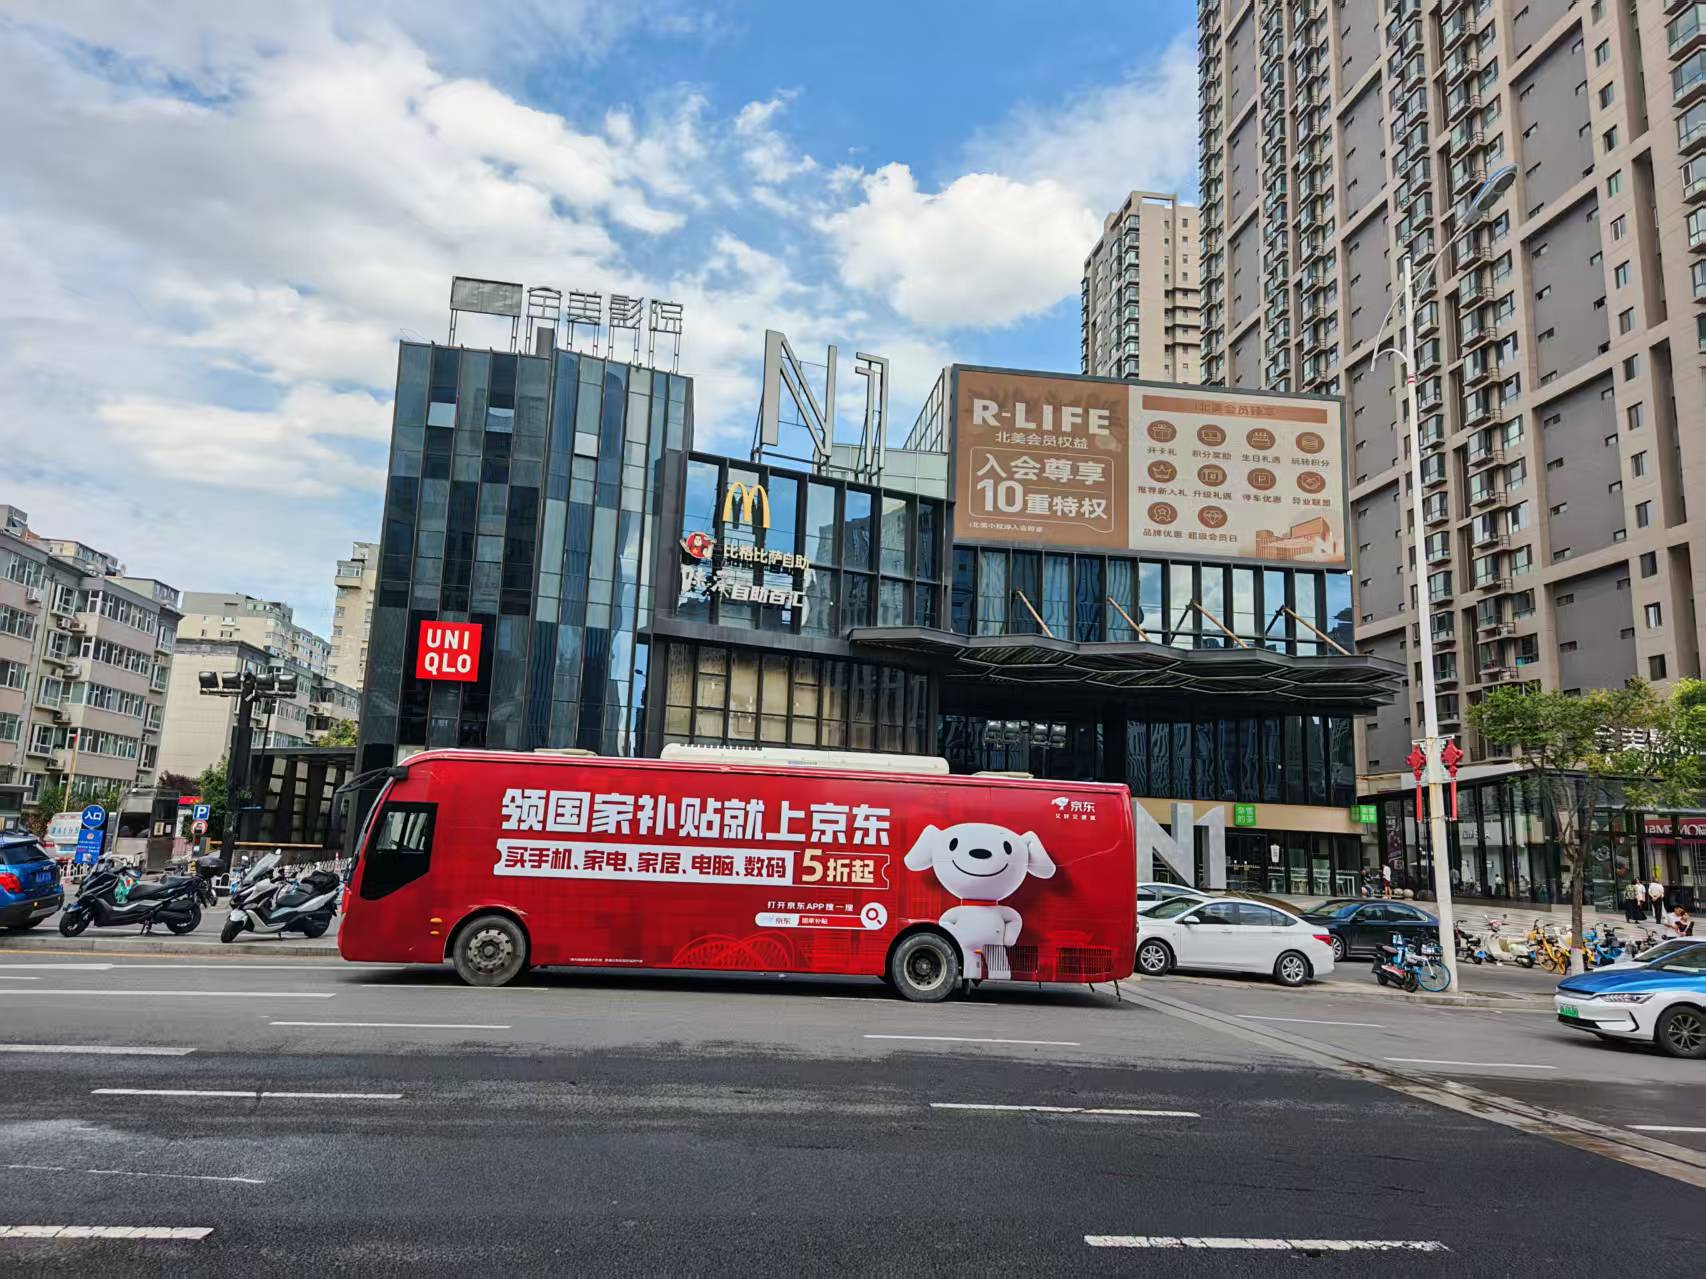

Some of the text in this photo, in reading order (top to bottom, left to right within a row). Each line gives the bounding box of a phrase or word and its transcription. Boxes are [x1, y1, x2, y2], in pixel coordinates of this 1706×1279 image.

[973, 398, 1111, 436] R-LIFE
[995, 431, 1089, 449] 北美会员权益
[976, 453, 1105, 486] 入会尊享
[976, 478, 1108, 519] 10重特权
[724, 543, 810, 570] 比格比萨自助
[426, 628, 470, 651] UNI
[424, 652, 472, 675] QLO
[84, 810, 103, 820] 入口
[197, 806, 207, 818] P
[501, 788, 891, 846] 领国家补贴就上京东
[1070, 801, 1096, 812] 京东
[504, 846, 786, 878] 买手机、家电、家居、电脑、数码
[802, 849, 874, 883] 5折起
[767, 900, 854, 912] 打开京东APP搜一搜
